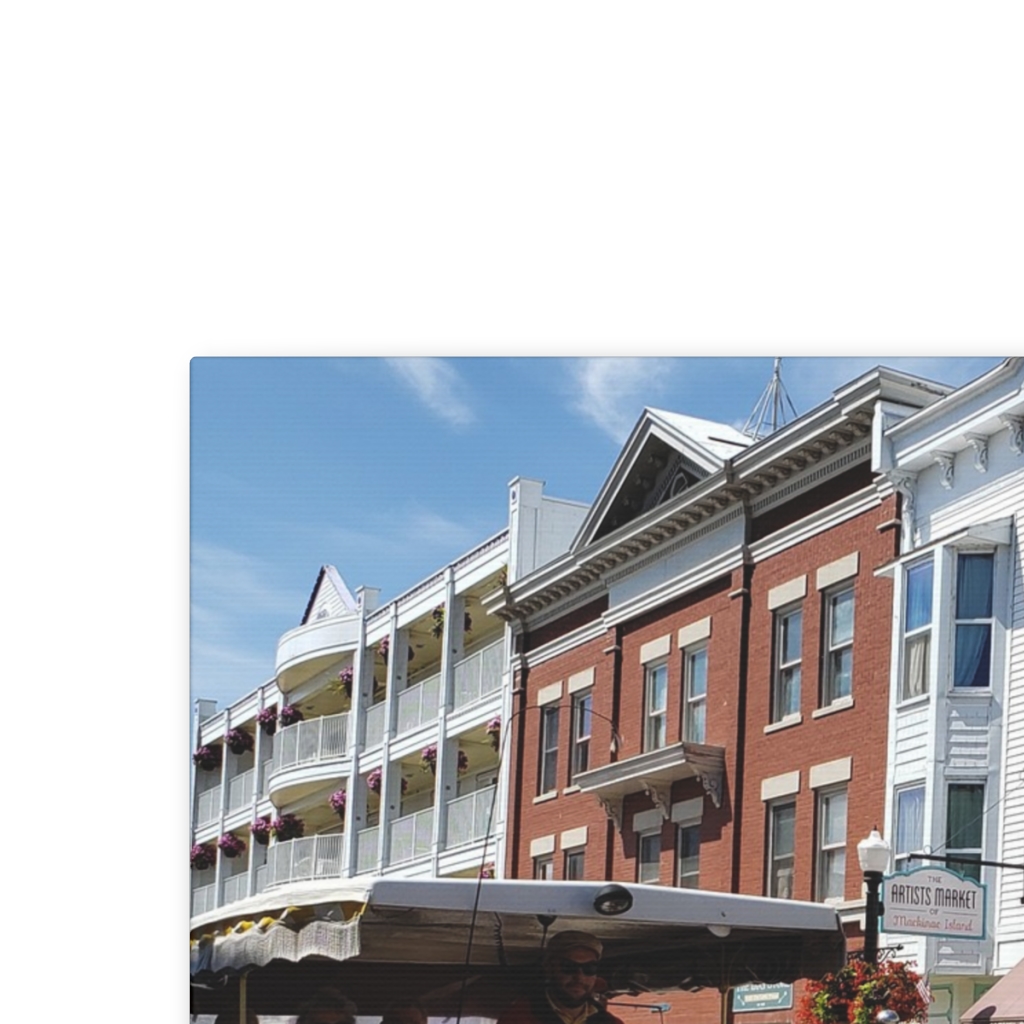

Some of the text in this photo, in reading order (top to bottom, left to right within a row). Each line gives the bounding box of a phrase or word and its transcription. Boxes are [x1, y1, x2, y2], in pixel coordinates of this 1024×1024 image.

[927, 875, 942, 884] THE
[891, 884, 977, 909] ARTISTS MARKET
[893, 914, 973, 931] Mackinac Island
